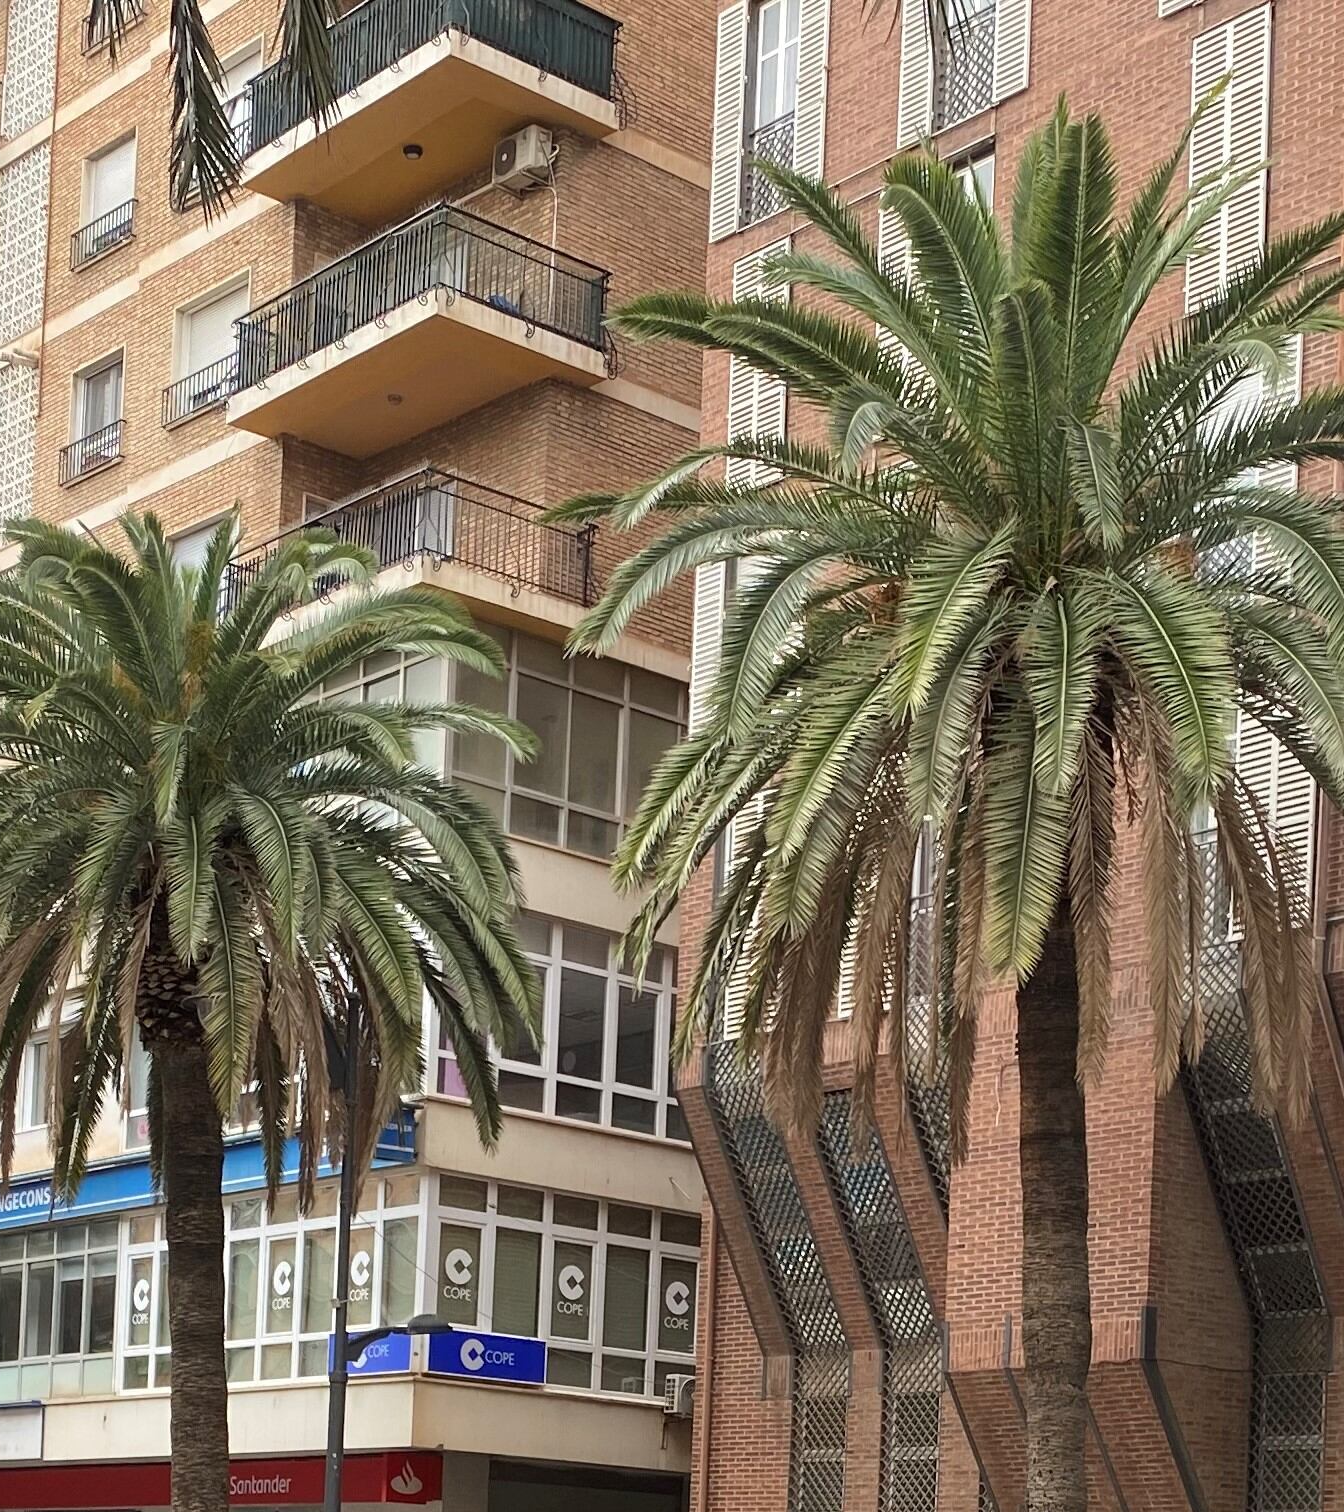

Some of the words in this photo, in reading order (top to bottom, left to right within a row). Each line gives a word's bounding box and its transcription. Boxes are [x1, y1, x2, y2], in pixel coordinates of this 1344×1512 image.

[349, 1288, 369, 1301] COPE
[443, 1285, 472, 1301] COPE
[272, 1297, 291, 1311] COPE
[556, 1301, 584, 1317] COPE
[132, 1313, 149, 1325] COPE
[663, 1317, 689, 1331] COPE
[367, 1344, 390, 1359] COPE
[484, 1350, 515, 1366] COPE
[229, 1474, 292, 1495] Santander
